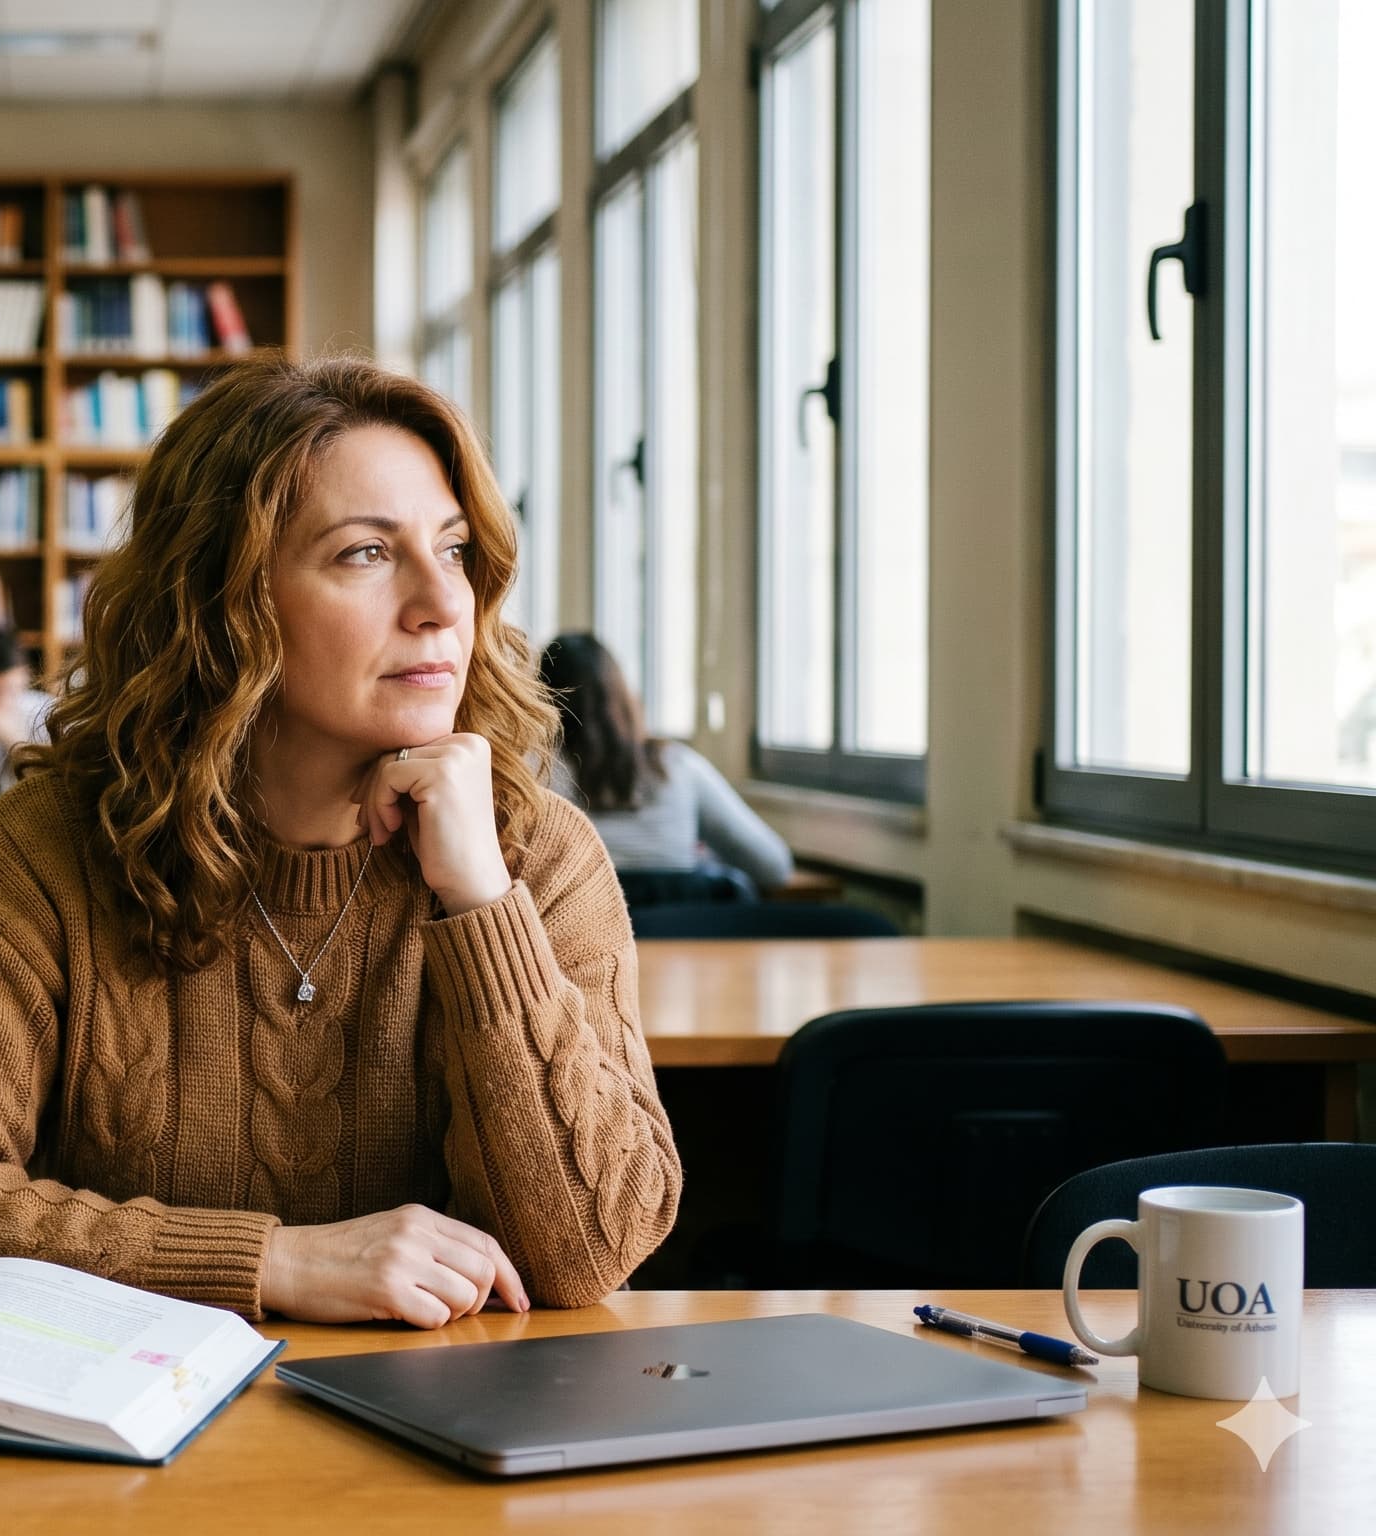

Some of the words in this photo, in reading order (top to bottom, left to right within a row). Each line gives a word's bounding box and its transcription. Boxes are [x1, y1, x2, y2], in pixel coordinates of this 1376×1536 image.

[1176, 1278, 1276, 1315] UOA
[1177, 1317, 1228, 1333] University
[1230, 1322, 1242, 1331] of
